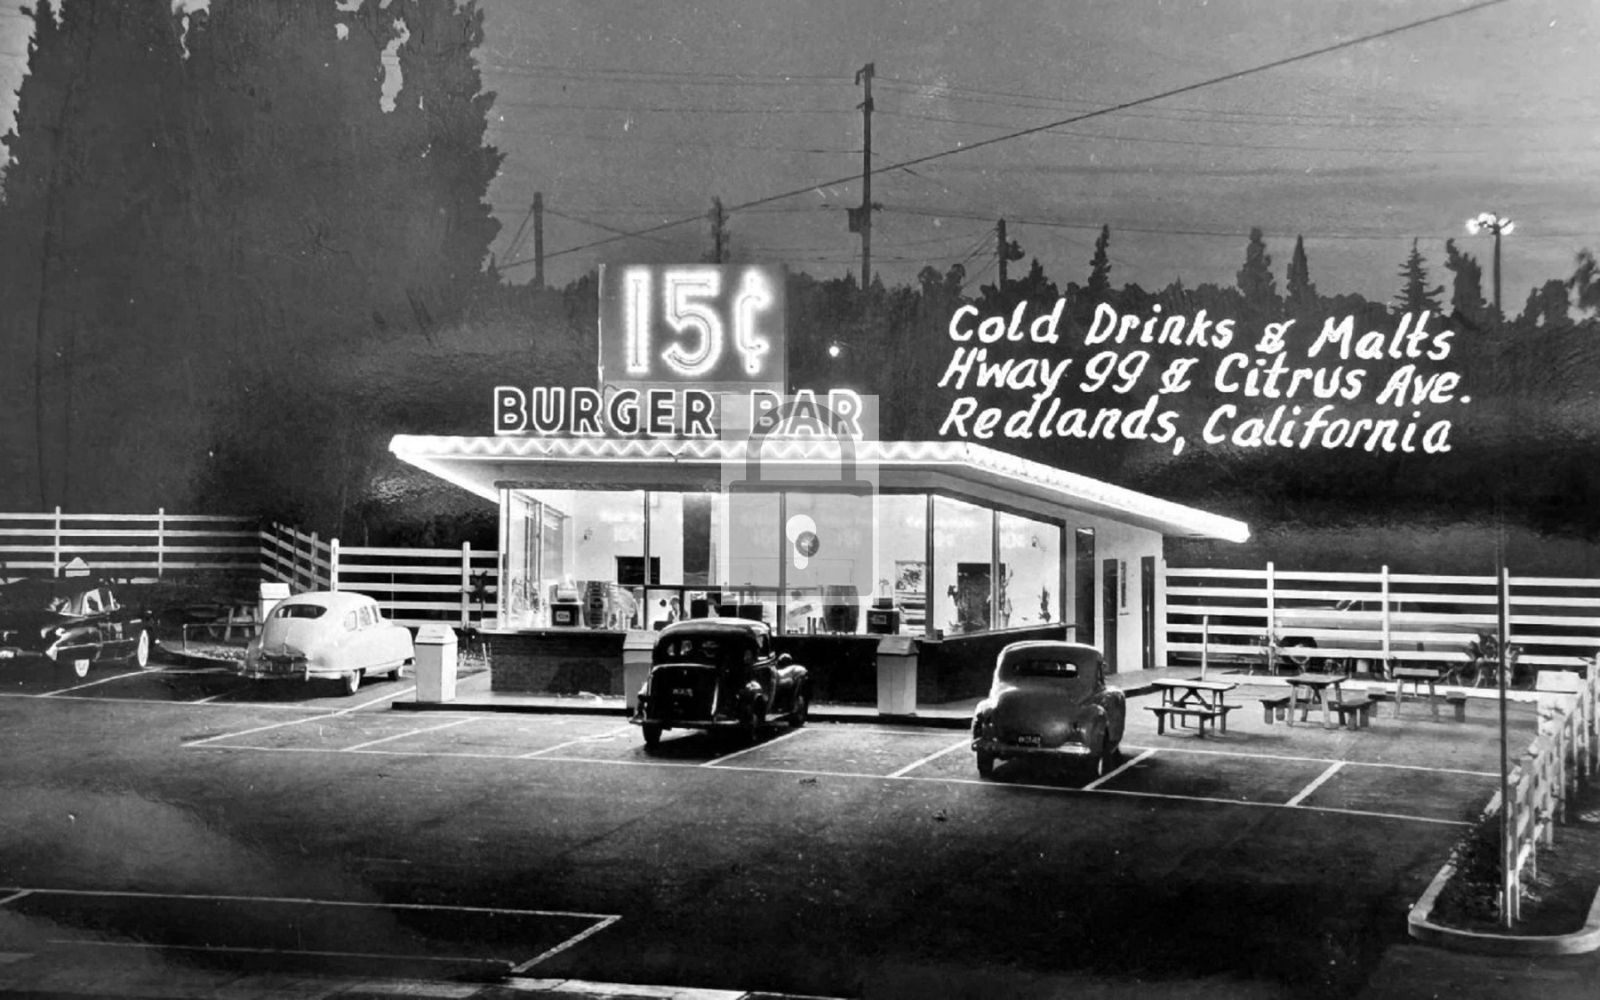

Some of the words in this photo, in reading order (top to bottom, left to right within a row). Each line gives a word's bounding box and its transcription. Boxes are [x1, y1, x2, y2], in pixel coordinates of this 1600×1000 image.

[623, 268, 772, 375] 15¢
[494, 386, 718, 437] BURGER
[749, 388, 865, 440] BAR
